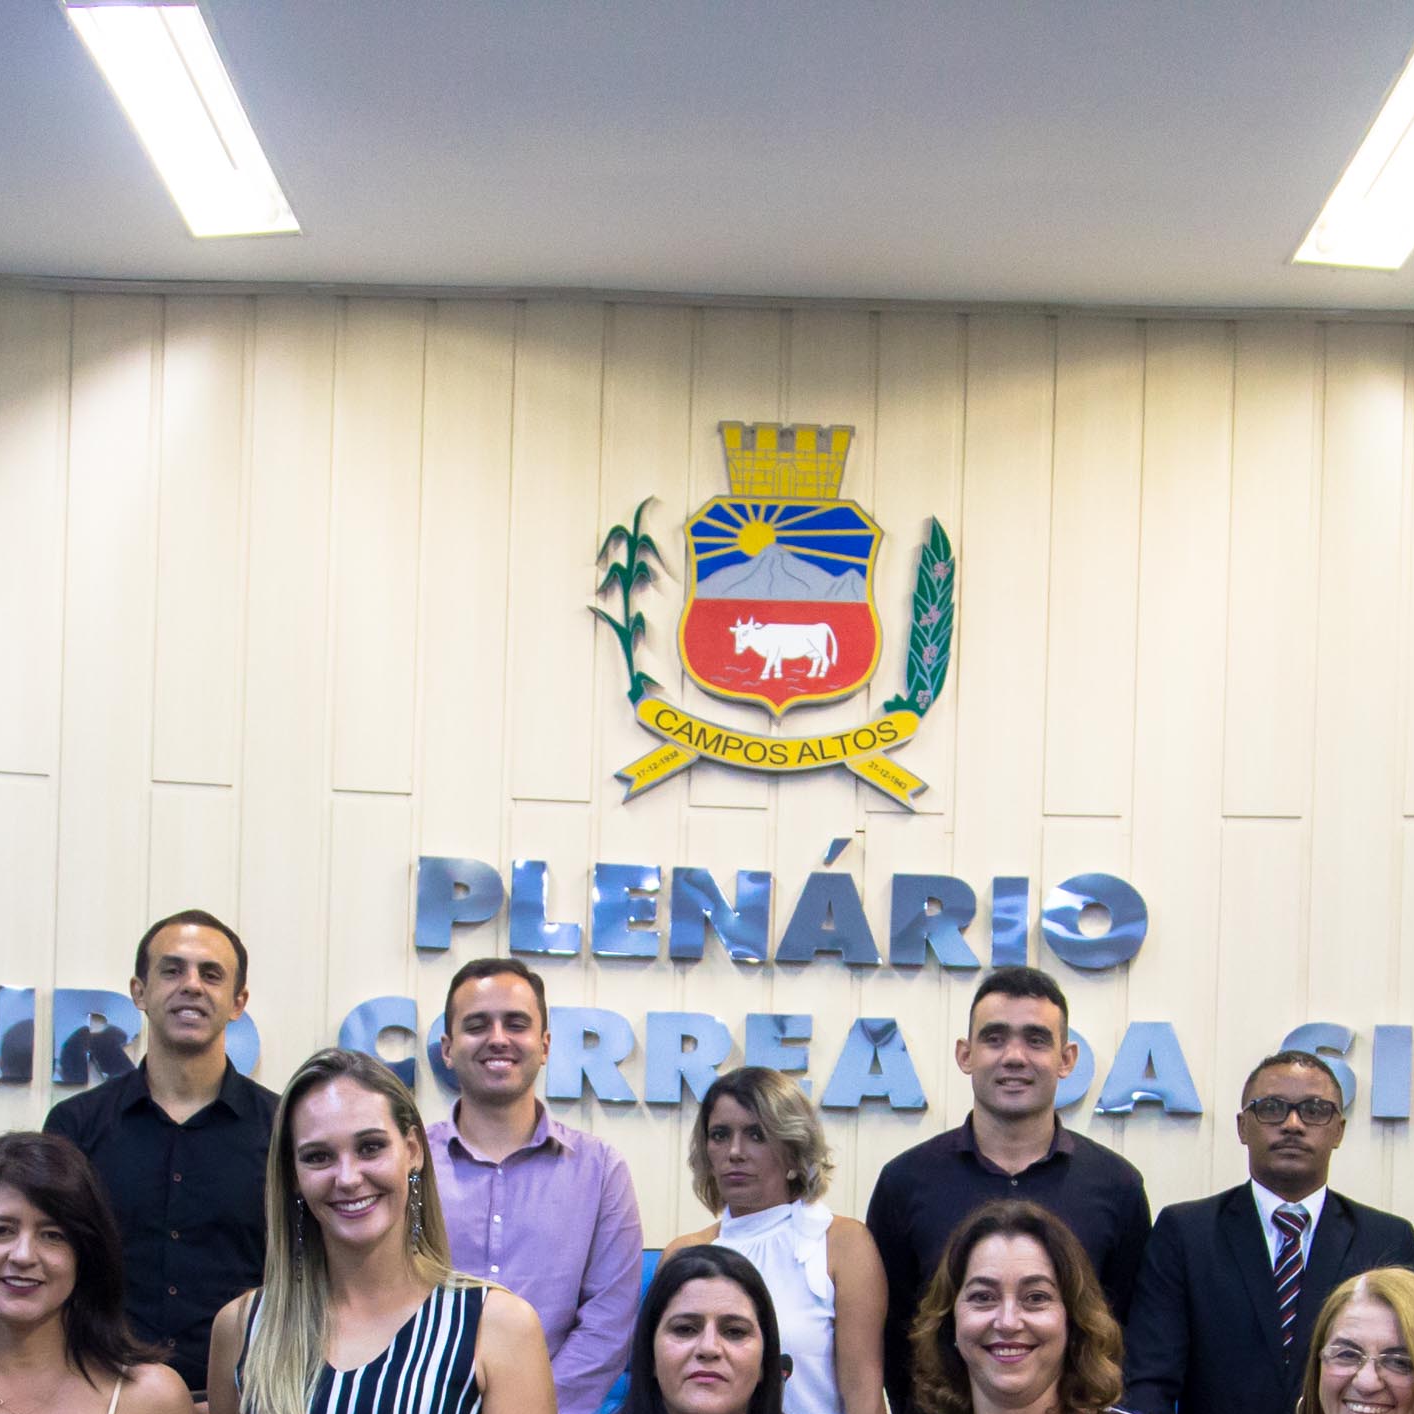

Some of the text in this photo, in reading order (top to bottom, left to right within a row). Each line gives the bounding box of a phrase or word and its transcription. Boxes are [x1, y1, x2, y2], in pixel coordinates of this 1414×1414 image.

[655, 709, 899, 764] CAMPOS ALTOS
[416, 837, 1148, 969] PLENÁRIO
[338, 996, 928, 1110] CRREA
